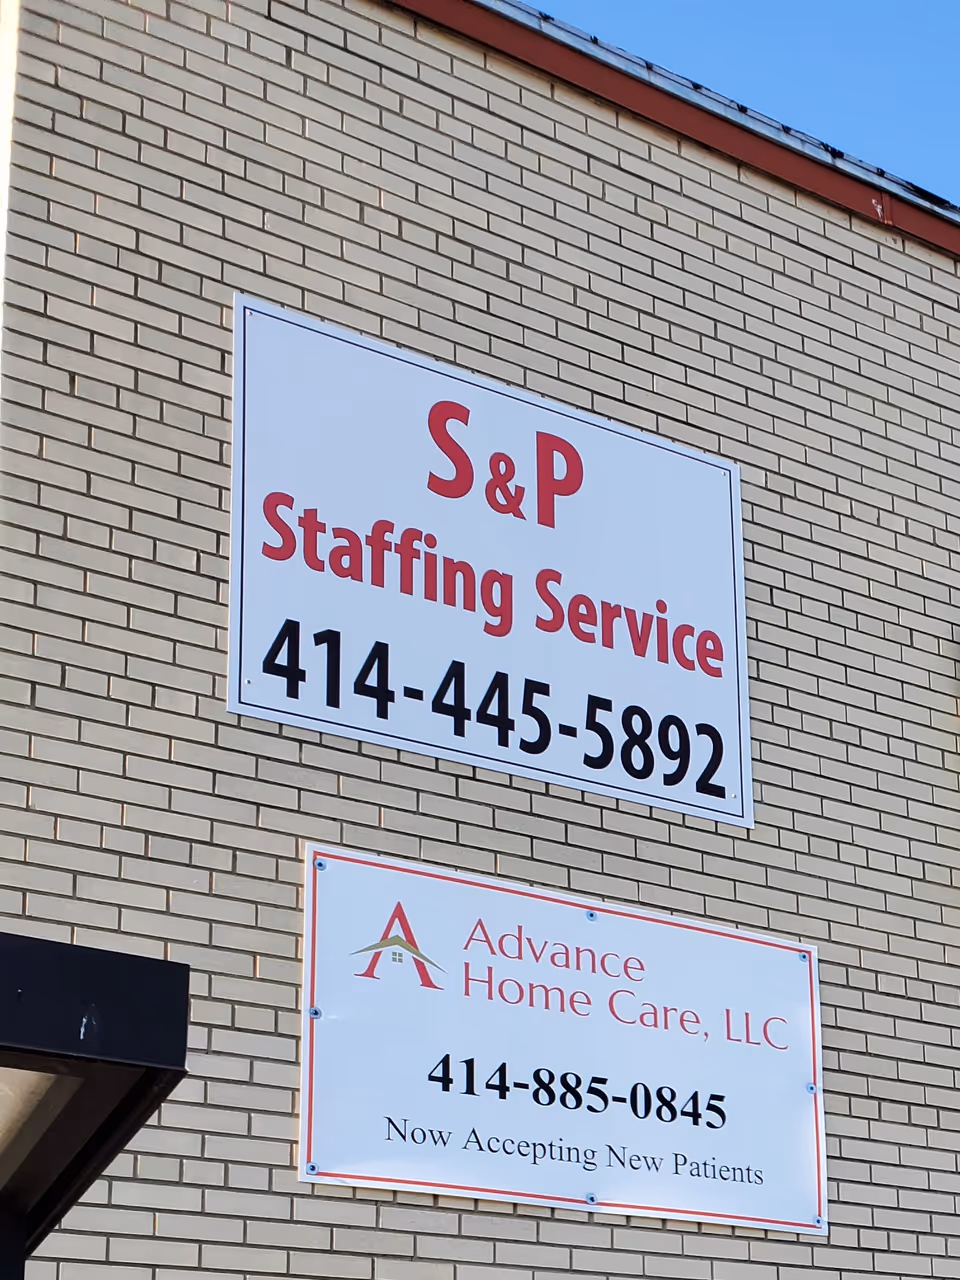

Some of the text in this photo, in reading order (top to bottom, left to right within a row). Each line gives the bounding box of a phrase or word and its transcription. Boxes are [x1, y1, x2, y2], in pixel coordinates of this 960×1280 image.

[261, 491, 724, 678] Staffing Service
[262, 617, 726, 799] 414-445-5892
[462, 917, 646, 983] Advance
[463, 961, 790, 1051] Home Care, LLC
[427, 1053, 728, 1130] 414-885-0845
[384, 1115, 765, 1187] Now Accepting New Patients
